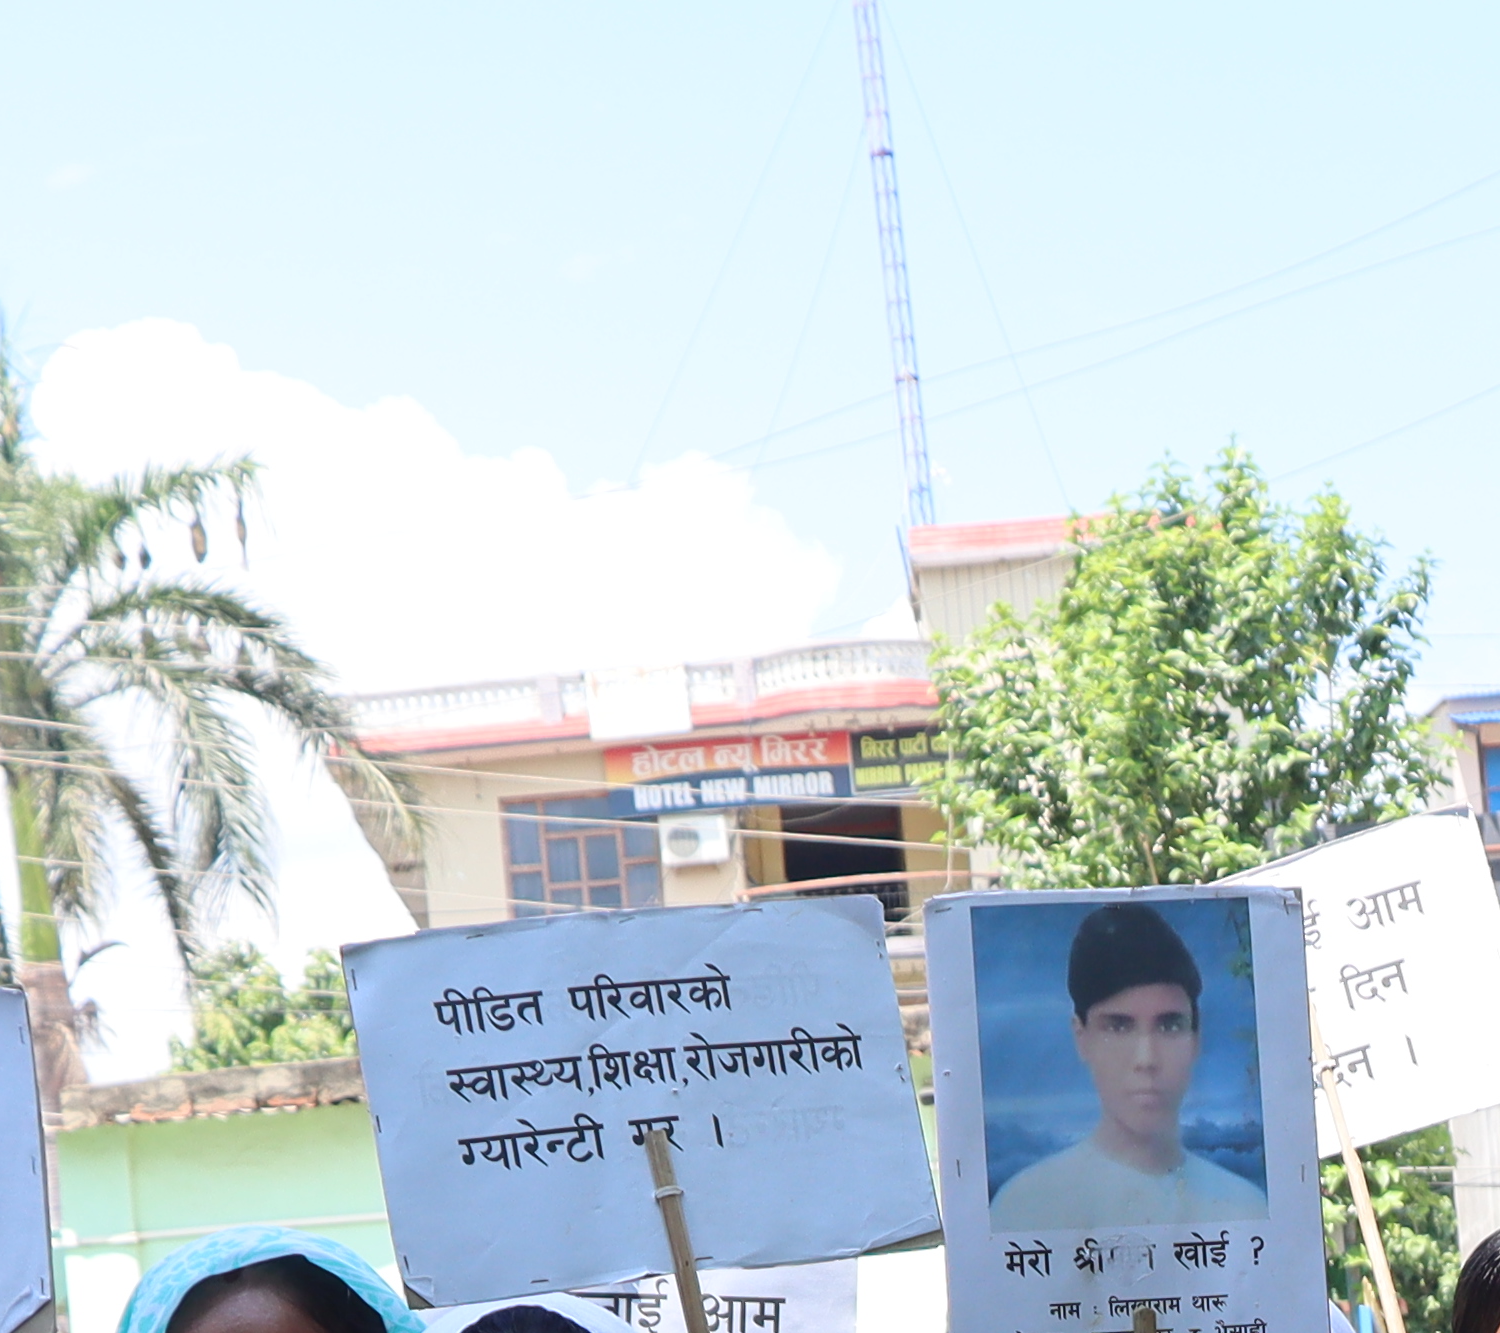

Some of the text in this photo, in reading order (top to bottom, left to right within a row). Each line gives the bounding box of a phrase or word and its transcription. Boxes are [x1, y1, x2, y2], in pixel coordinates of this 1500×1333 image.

[632, 745, 704, 776] होटल
[633, 771, 835, 811] HOTEL NEW MIRROR
[1346, 880, 1424, 930] आम
[433, 963, 732, 1035] पीडित परिवारको
[1339, 958, 1408, 1011] दिन
[458, 1113, 604, 1170] ग्यारेन्टी
[1005, 1239, 1053, 1278] मेरो
[1173, 1230, 1230, 1270] खोई
[1049, 1301, 1082, 1321] नाम
